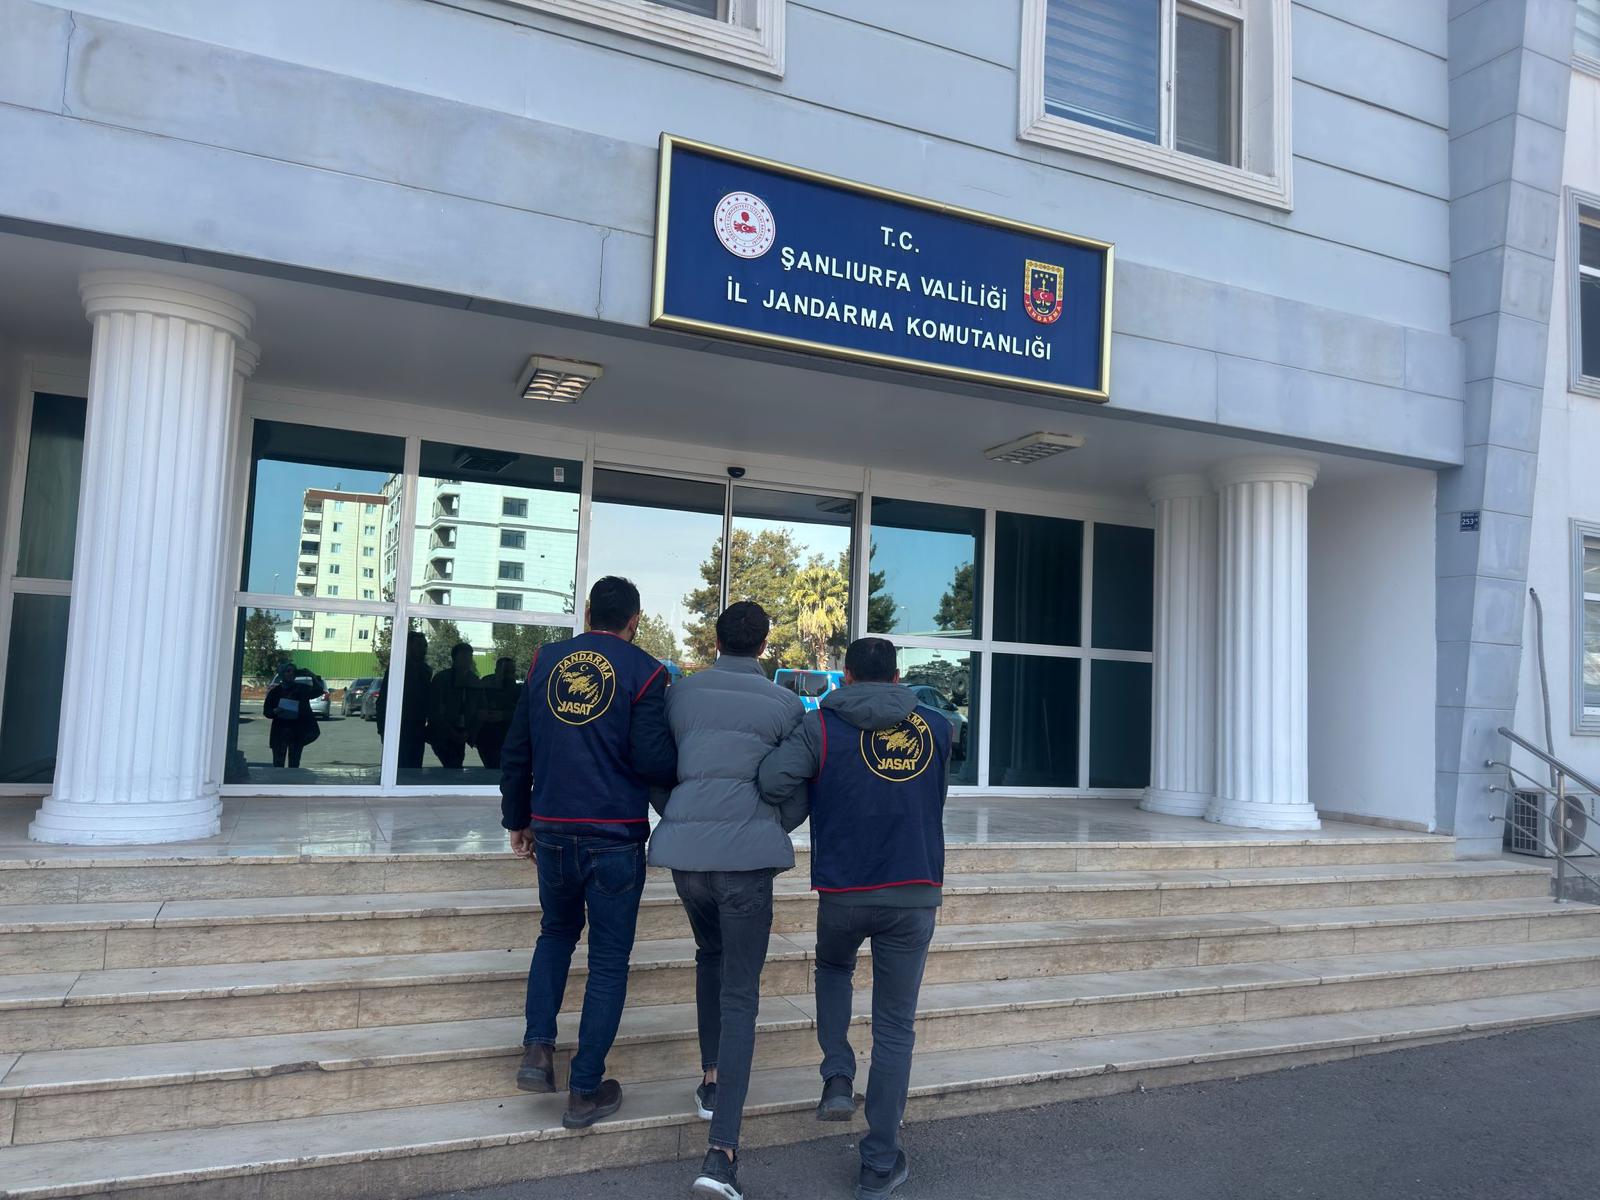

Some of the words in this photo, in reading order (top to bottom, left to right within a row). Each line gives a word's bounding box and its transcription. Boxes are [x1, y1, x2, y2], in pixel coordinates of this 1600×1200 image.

[880, 225, 920, 253] T.C.
[780, 246, 911, 292] ŞANLIURFA
[920, 276, 1007, 311] VALİLİĞİ
[727, 275, 748, 304] İL
[762, 289, 894, 332] JANDARMA
[907, 316, 1052, 361] KOMUTANLIĞI
[558, 653, 613, 680] JANDARMA
[557, 700, 594, 716] JASAT
[877, 757, 918, 771] JASAT
